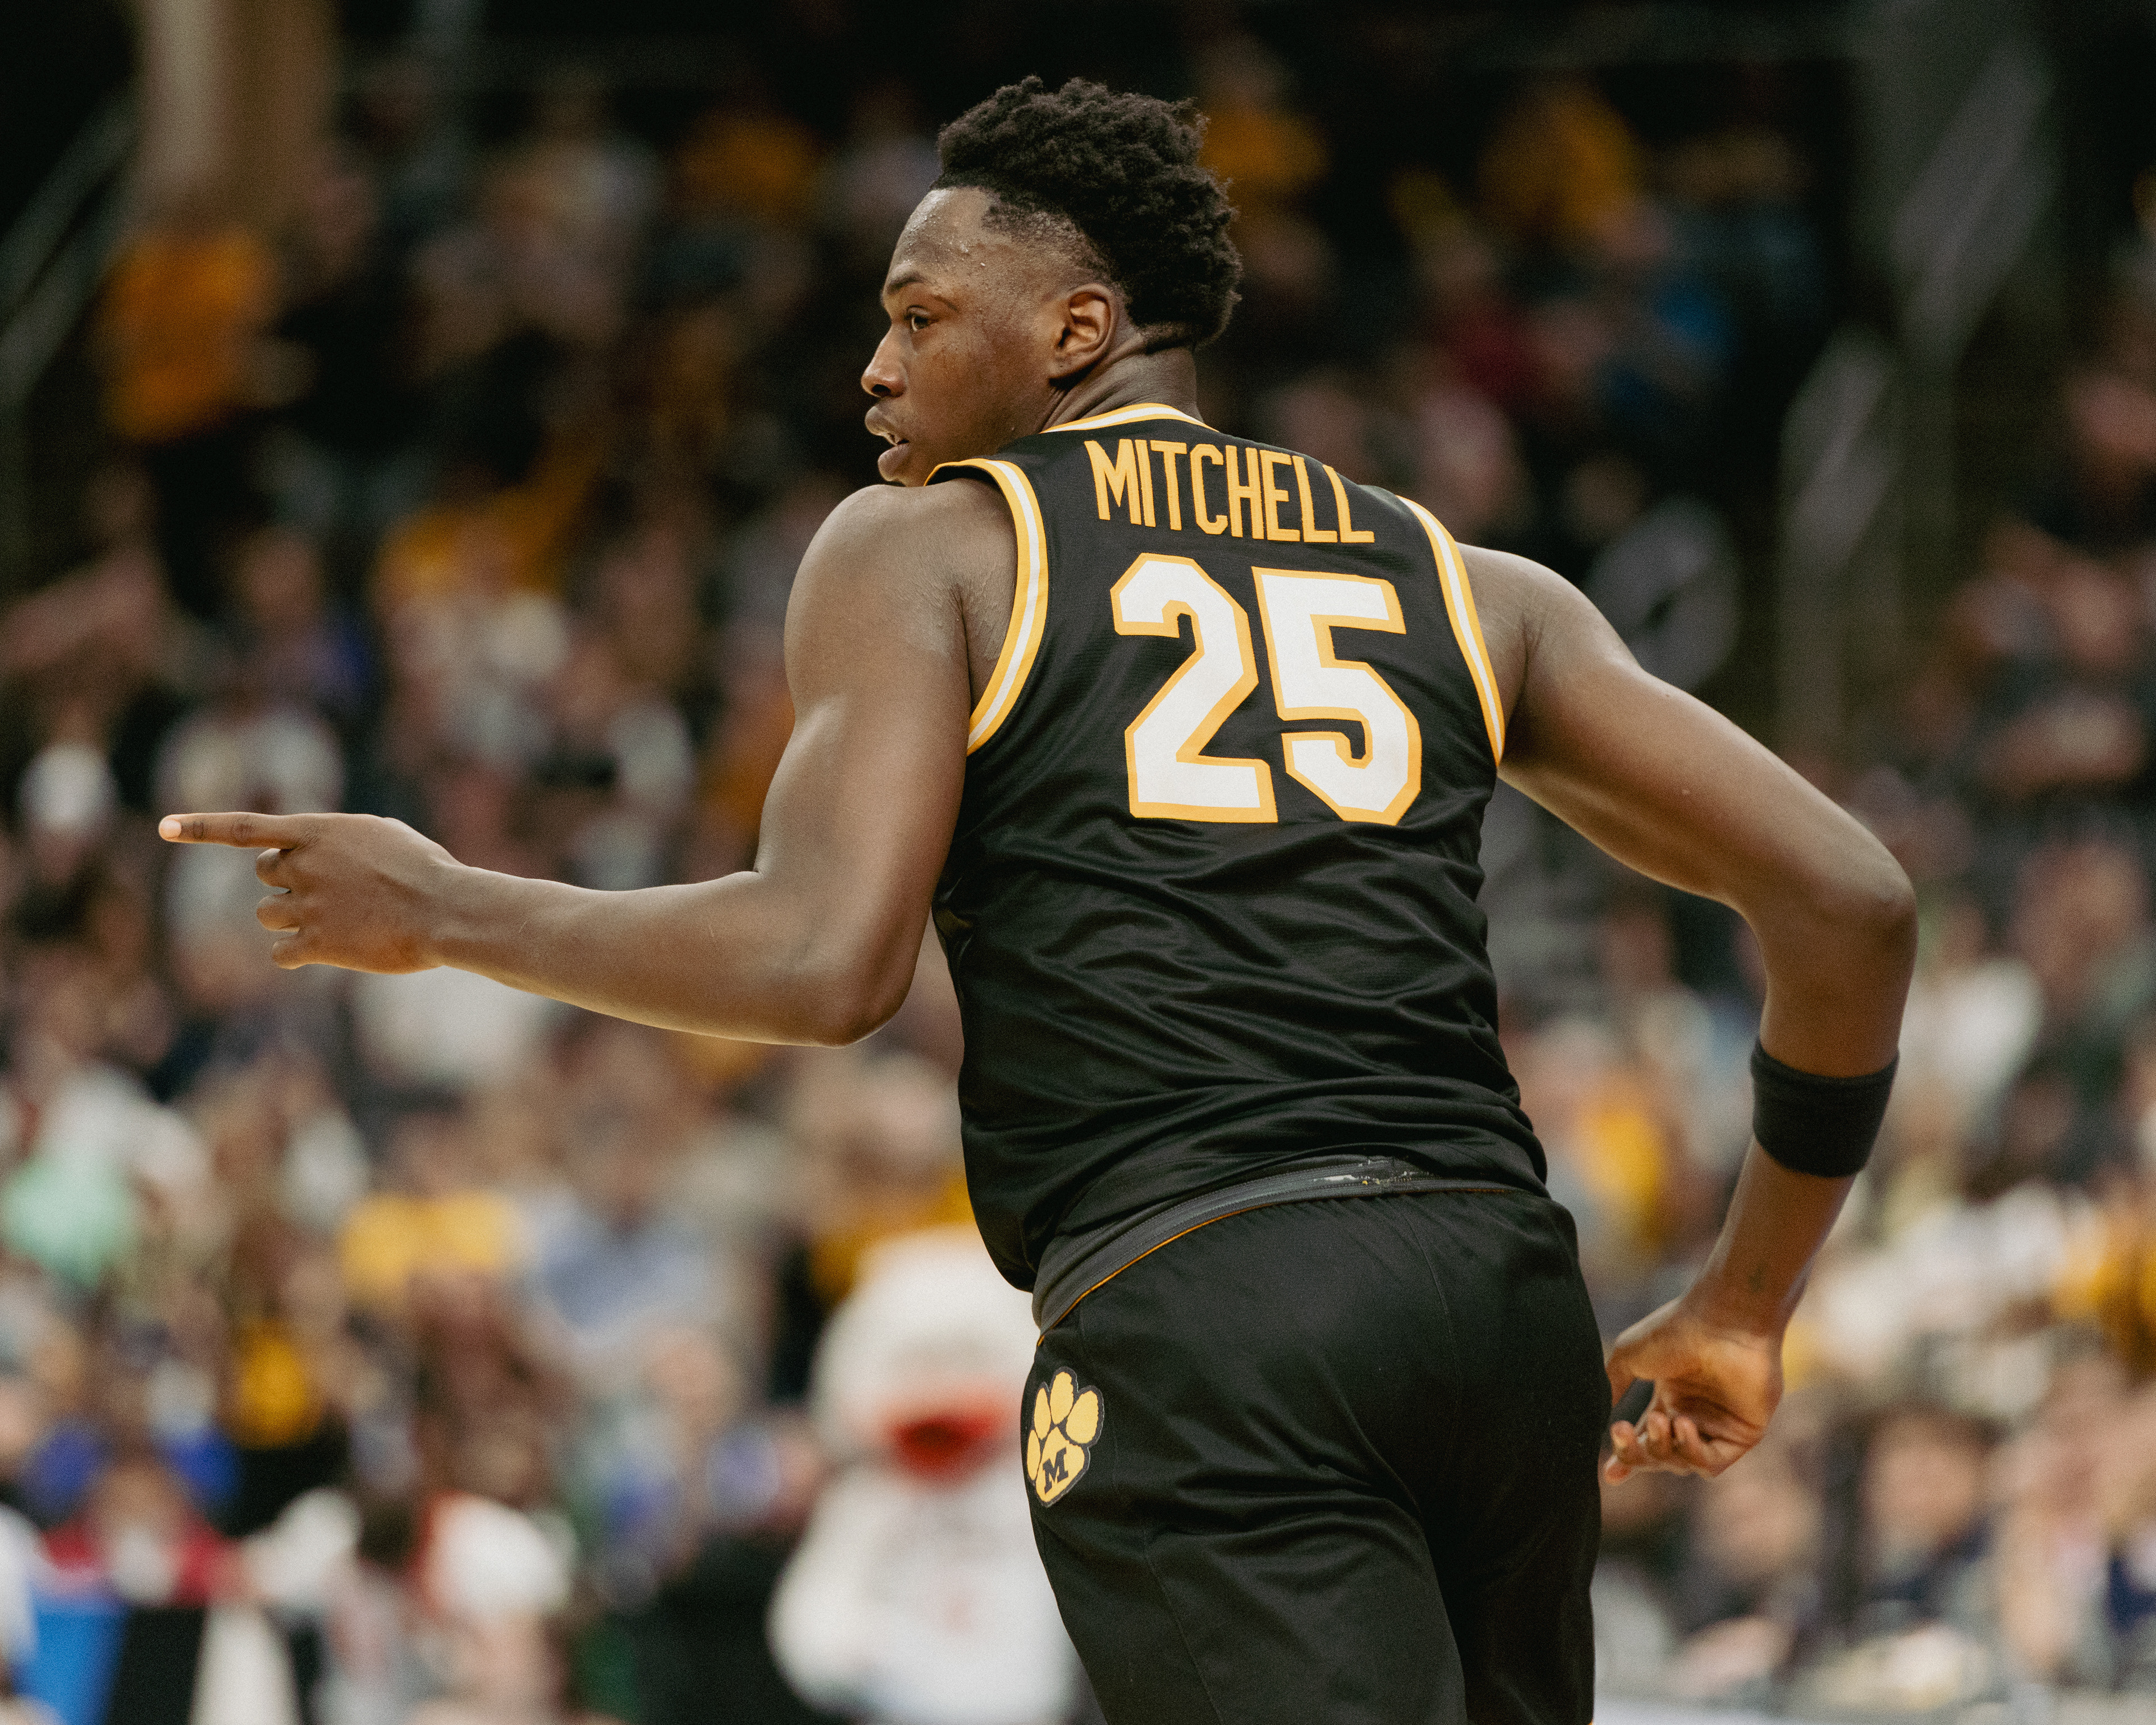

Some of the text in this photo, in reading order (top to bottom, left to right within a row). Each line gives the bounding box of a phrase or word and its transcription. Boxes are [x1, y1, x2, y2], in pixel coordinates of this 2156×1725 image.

[1084, 439, 1375, 543] MITCHELL
[1110, 553, 1422, 826] 25
[1043, 1447, 1069, 1495] M
